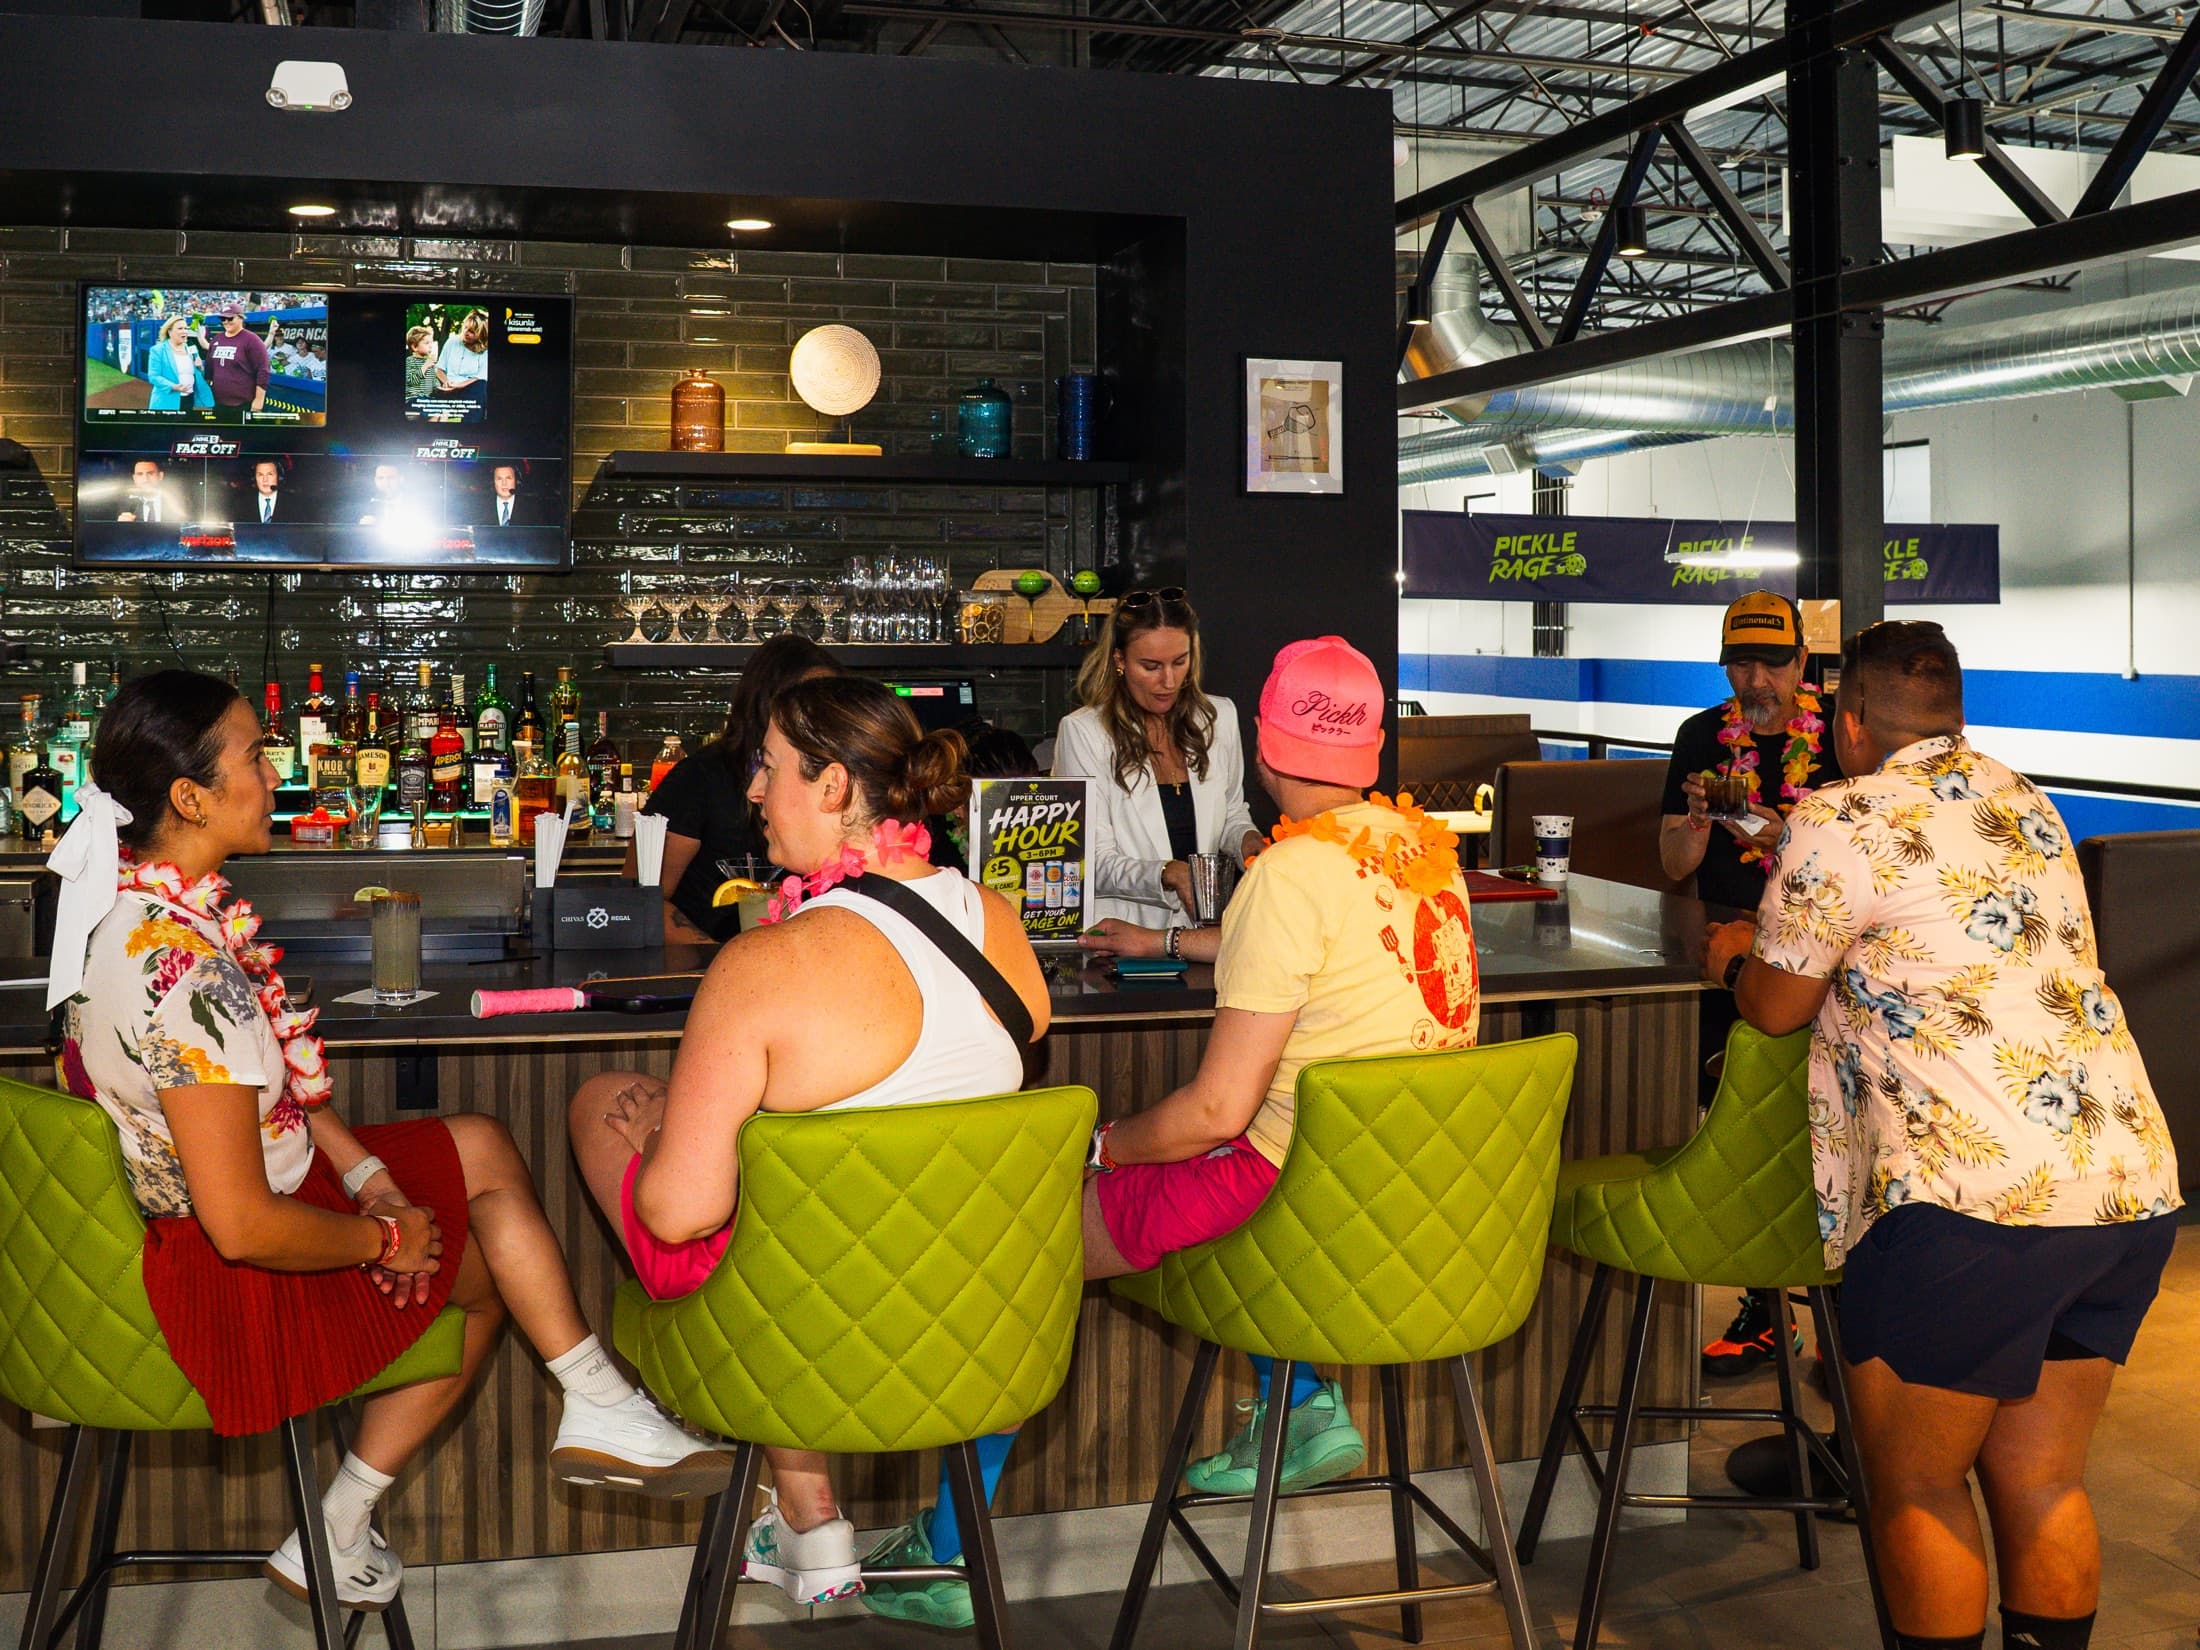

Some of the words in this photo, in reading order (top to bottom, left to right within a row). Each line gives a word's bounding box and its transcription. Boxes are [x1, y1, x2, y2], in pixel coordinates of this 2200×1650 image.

[176, 443, 208, 454] FACE
[211, 444, 236, 455] OFF
[416, 447, 448, 458] FACE
[450, 448, 475, 458] OFF
[181, 534, 232, 547] verizon
[1494, 531, 1577, 557] PICKLE
[1489, 554, 1558, 584] RAGE
[1292, 690, 1367, 726] Picklr
[359, 751, 387, 760] JAMESON
[434, 752, 462, 766] APEROL
[318, 760, 343, 771] KNOB
[988, 800, 1080, 834] HAPPY
[992, 820, 1080, 854] HOUR
[991, 859, 1010, 876] $5
[1023, 910, 1042, 919] GET
[1045, 908, 1066, 917] YOUR
[1022, 917, 1054, 931] RAGE
[1057, 912, 1079, 926] ON!
